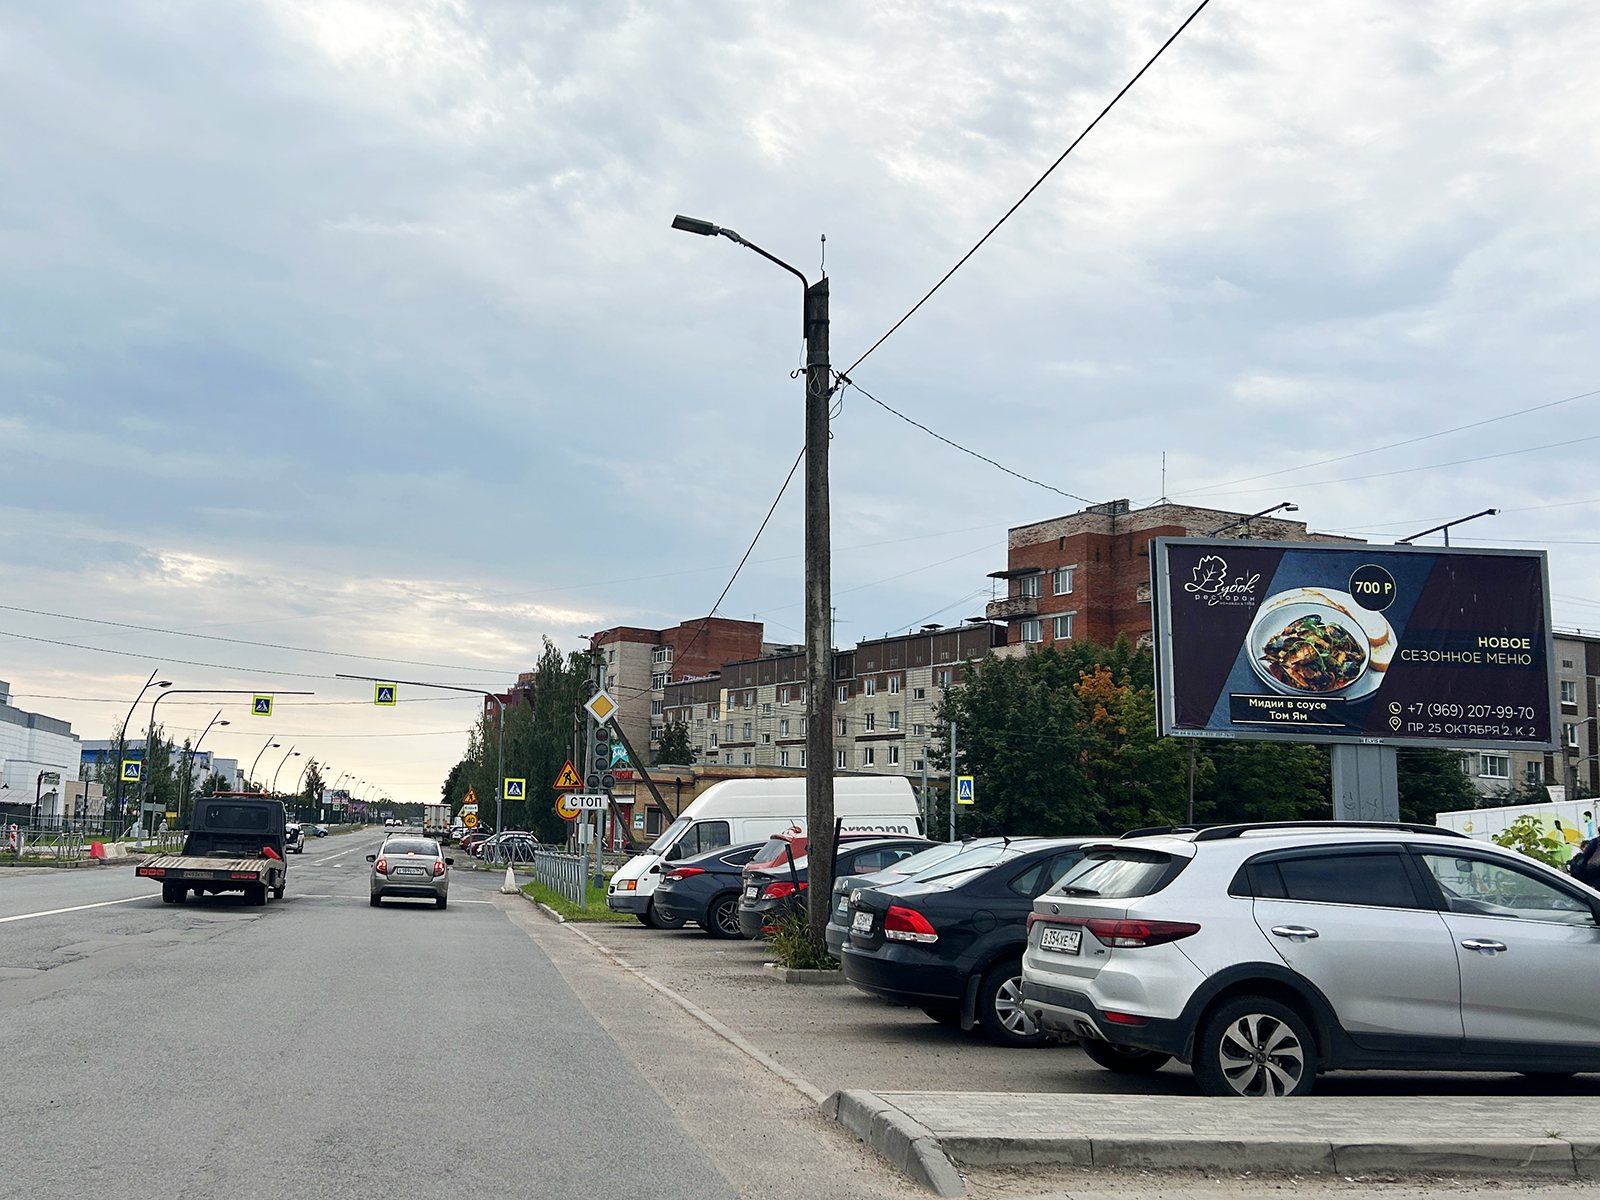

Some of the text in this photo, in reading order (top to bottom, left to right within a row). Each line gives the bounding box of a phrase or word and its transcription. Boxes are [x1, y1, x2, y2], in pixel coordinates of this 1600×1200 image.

[1355, 581, 1381, 594] 700
[1194, 594, 1256, 602] ресторан
[1478, 636, 1531, 650] НОВОЕ
[1400, 649, 1532, 666] СЕЗОННОЕ МЕНЮ
[1249, 698, 1327, 711] Мидии в соусе
[1407, 702, 1535, 720] +7 (969) 207-99-70
[1269, 710, 1308, 721] Том Ям
[1407, 722, 1425, 733] ПР.
[1428, 723, 1442, 733] 25
[1444, 723, 1500, 735] ОКТЯБРЯ
[1528, 727, 1536, 737] 2
[570, 797, 602, 807] СТОП
